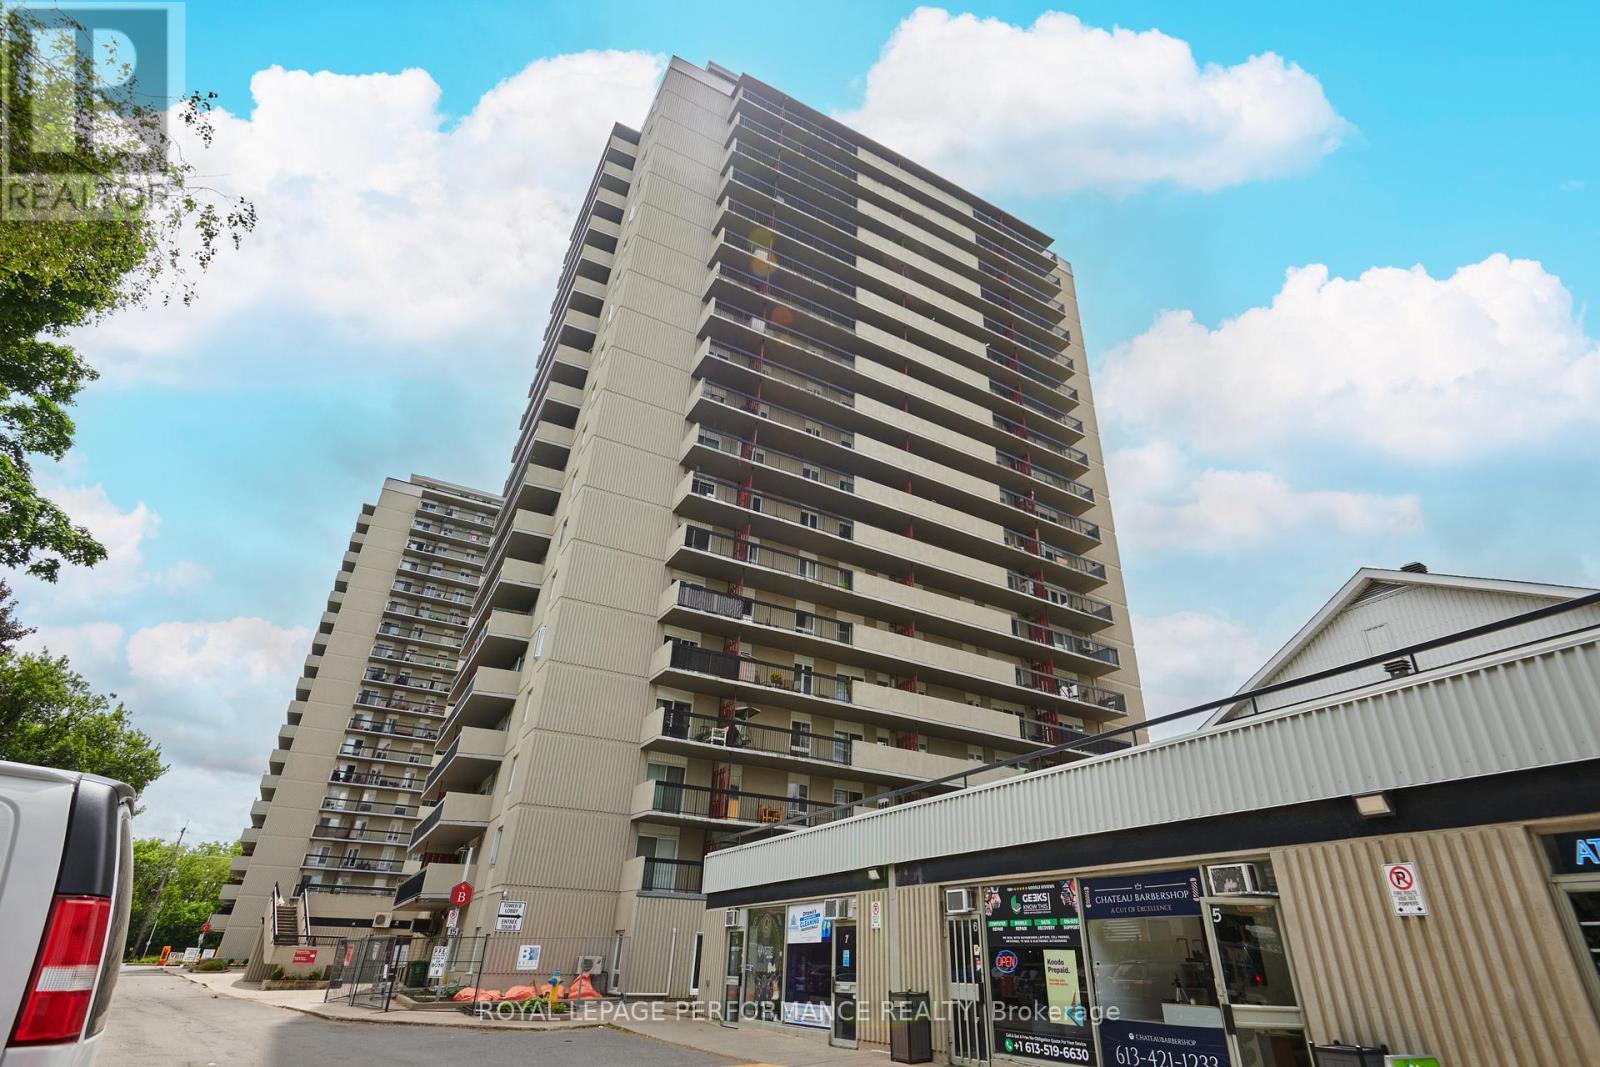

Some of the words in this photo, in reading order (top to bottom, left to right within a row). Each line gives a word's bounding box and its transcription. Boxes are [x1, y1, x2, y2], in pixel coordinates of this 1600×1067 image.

[457, 891, 466, 903] B
[1095, 893, 1133, 904] CHATEAU
[1134, 890, 1189, 902] BARBERSHOP
[1136, 904, 1173, 912] EXCELLENCE
[1212, 908, 1222, 923] 5
[995, 955, 1016, 968] OPEN
[1047, 958, 1065, 966] Koodo
[1048, 966, 1070, 974] Prepaid.
[1014, 1041, 1023, 1052] +1
[1025, 1042, 1089, 1061] 613-519-6630
